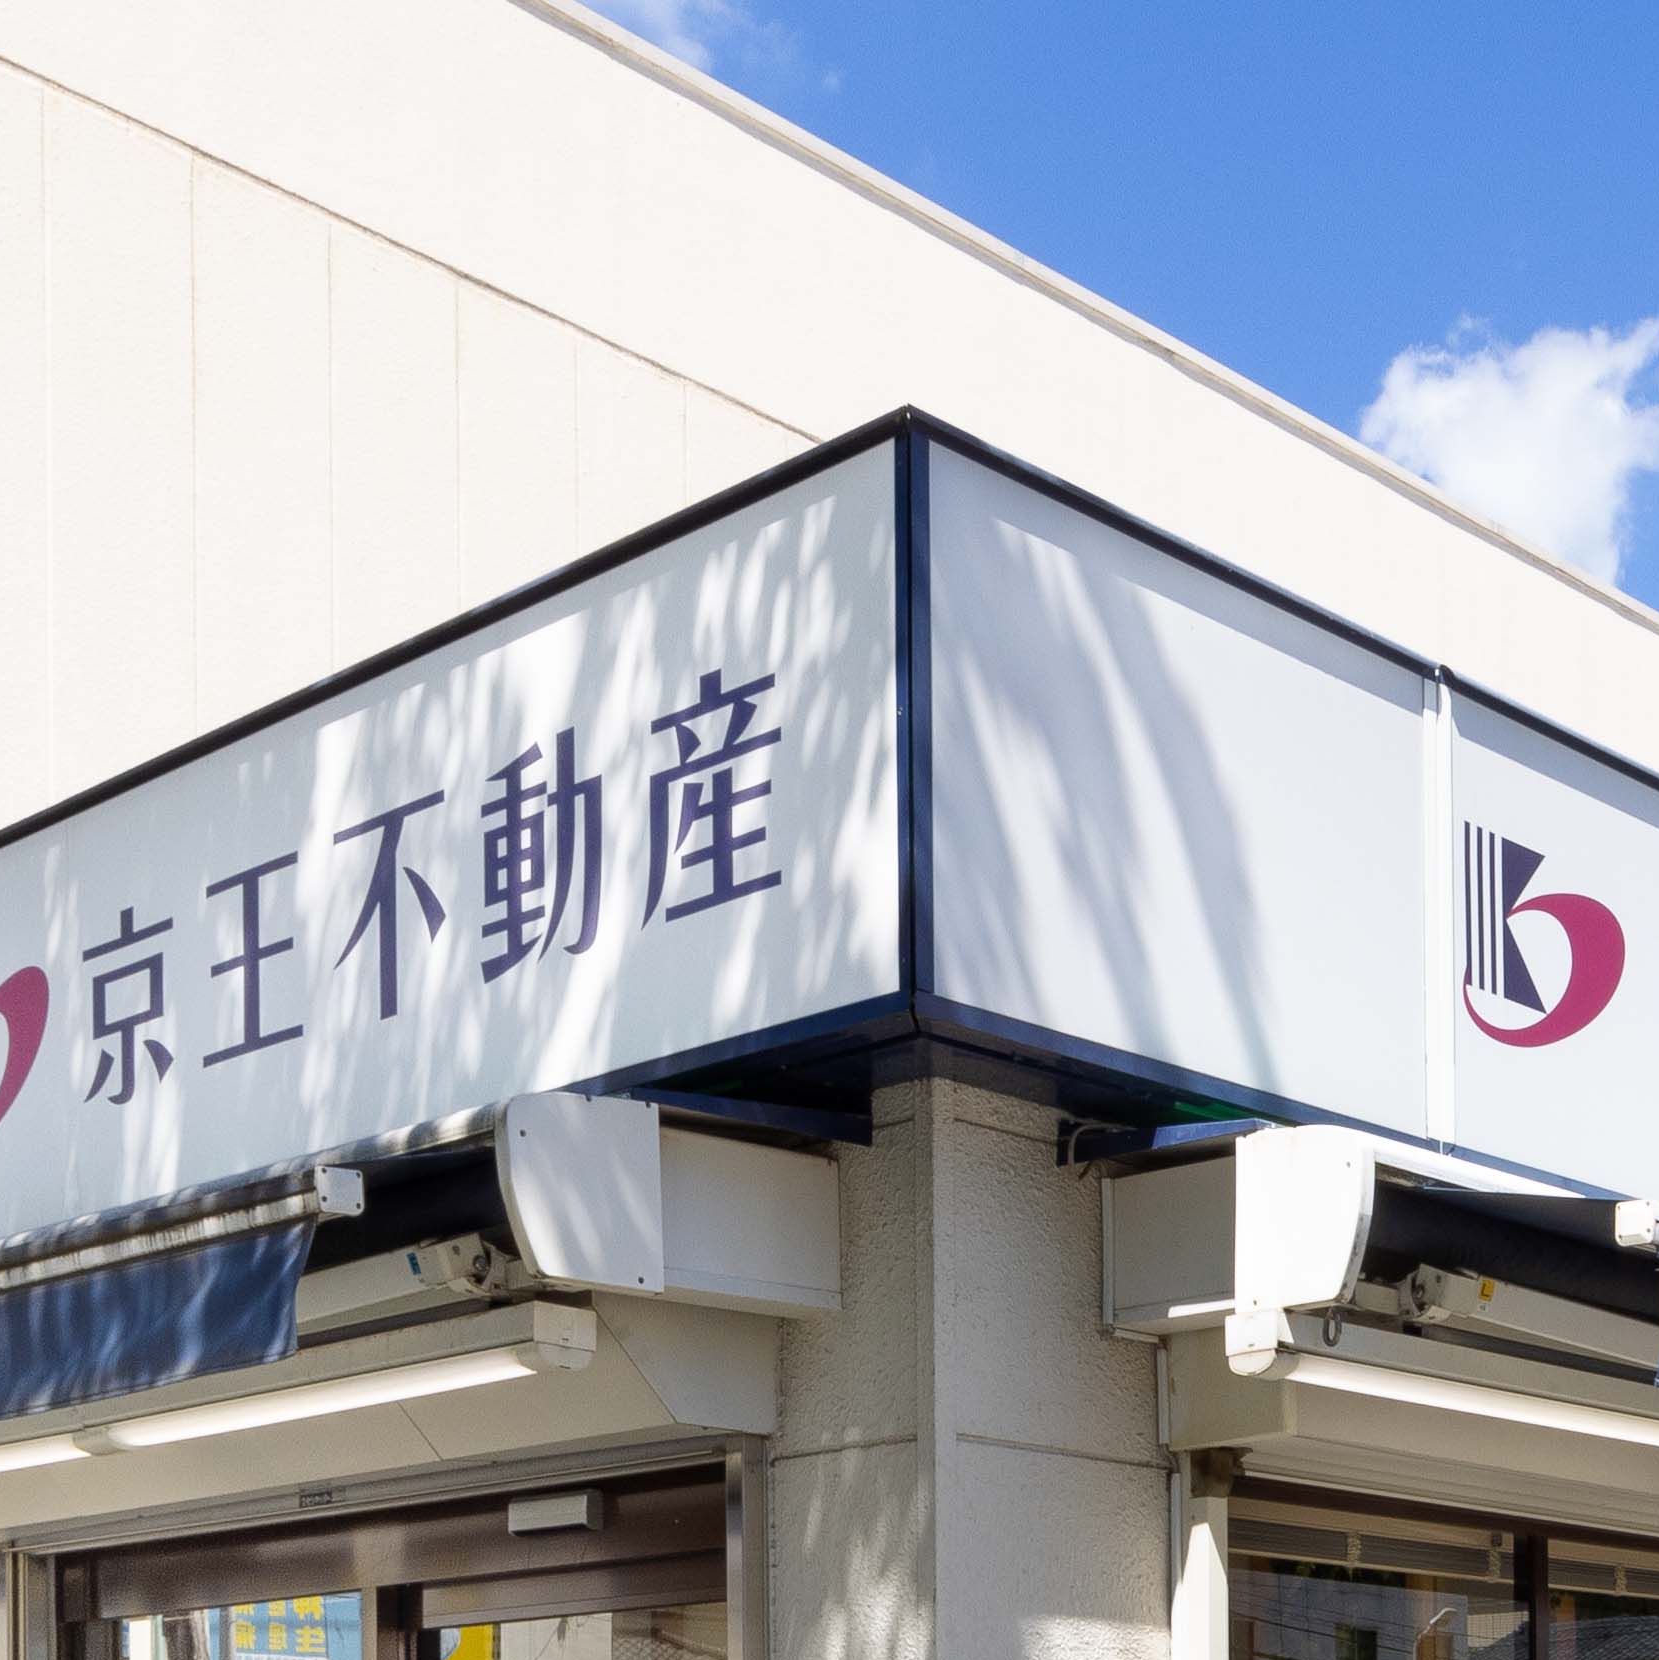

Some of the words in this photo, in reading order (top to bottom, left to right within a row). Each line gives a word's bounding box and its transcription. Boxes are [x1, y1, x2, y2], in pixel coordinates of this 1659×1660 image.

[81, 668, 784, 1106] 京王不動産
